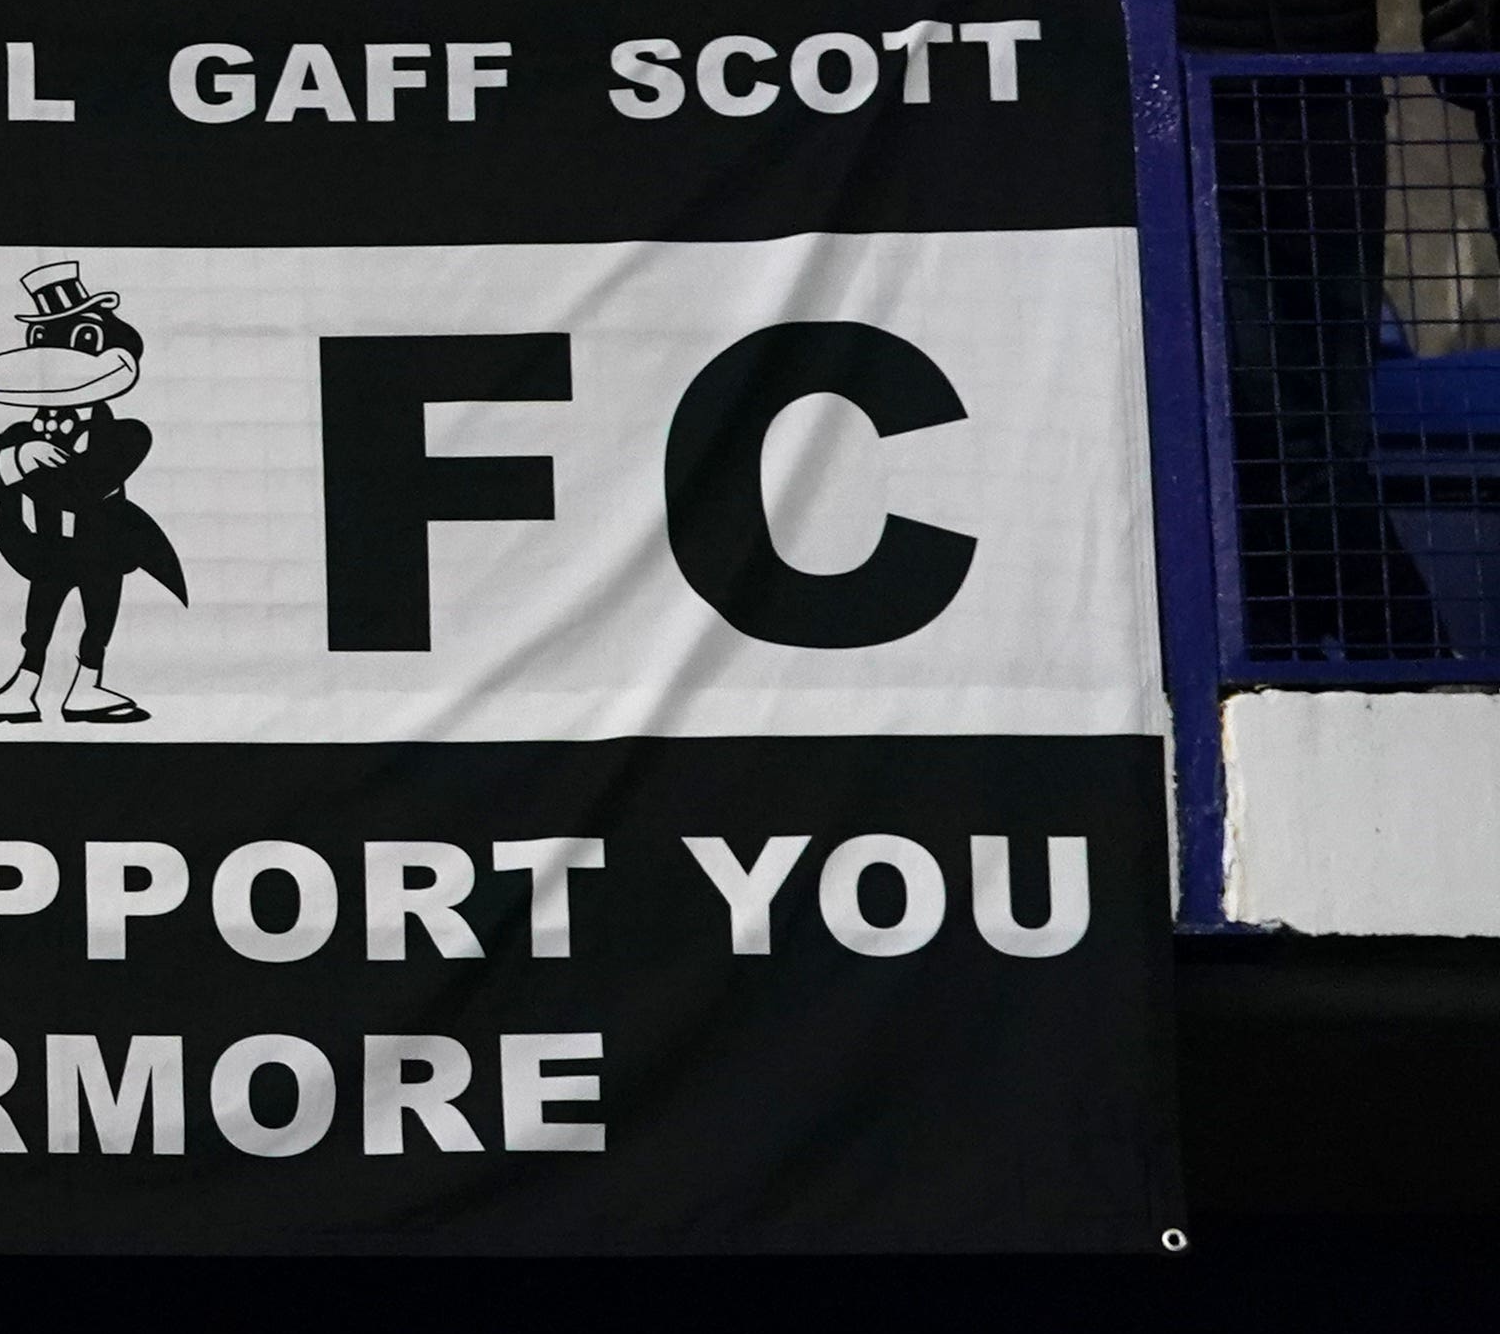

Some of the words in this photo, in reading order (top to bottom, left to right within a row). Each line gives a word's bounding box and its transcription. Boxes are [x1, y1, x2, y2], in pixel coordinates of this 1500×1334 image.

[168, 41, 513, 123] GAFF
[608, 19, 1041, 119] SCOTT
[680, 833, 1092, 959] YOU
